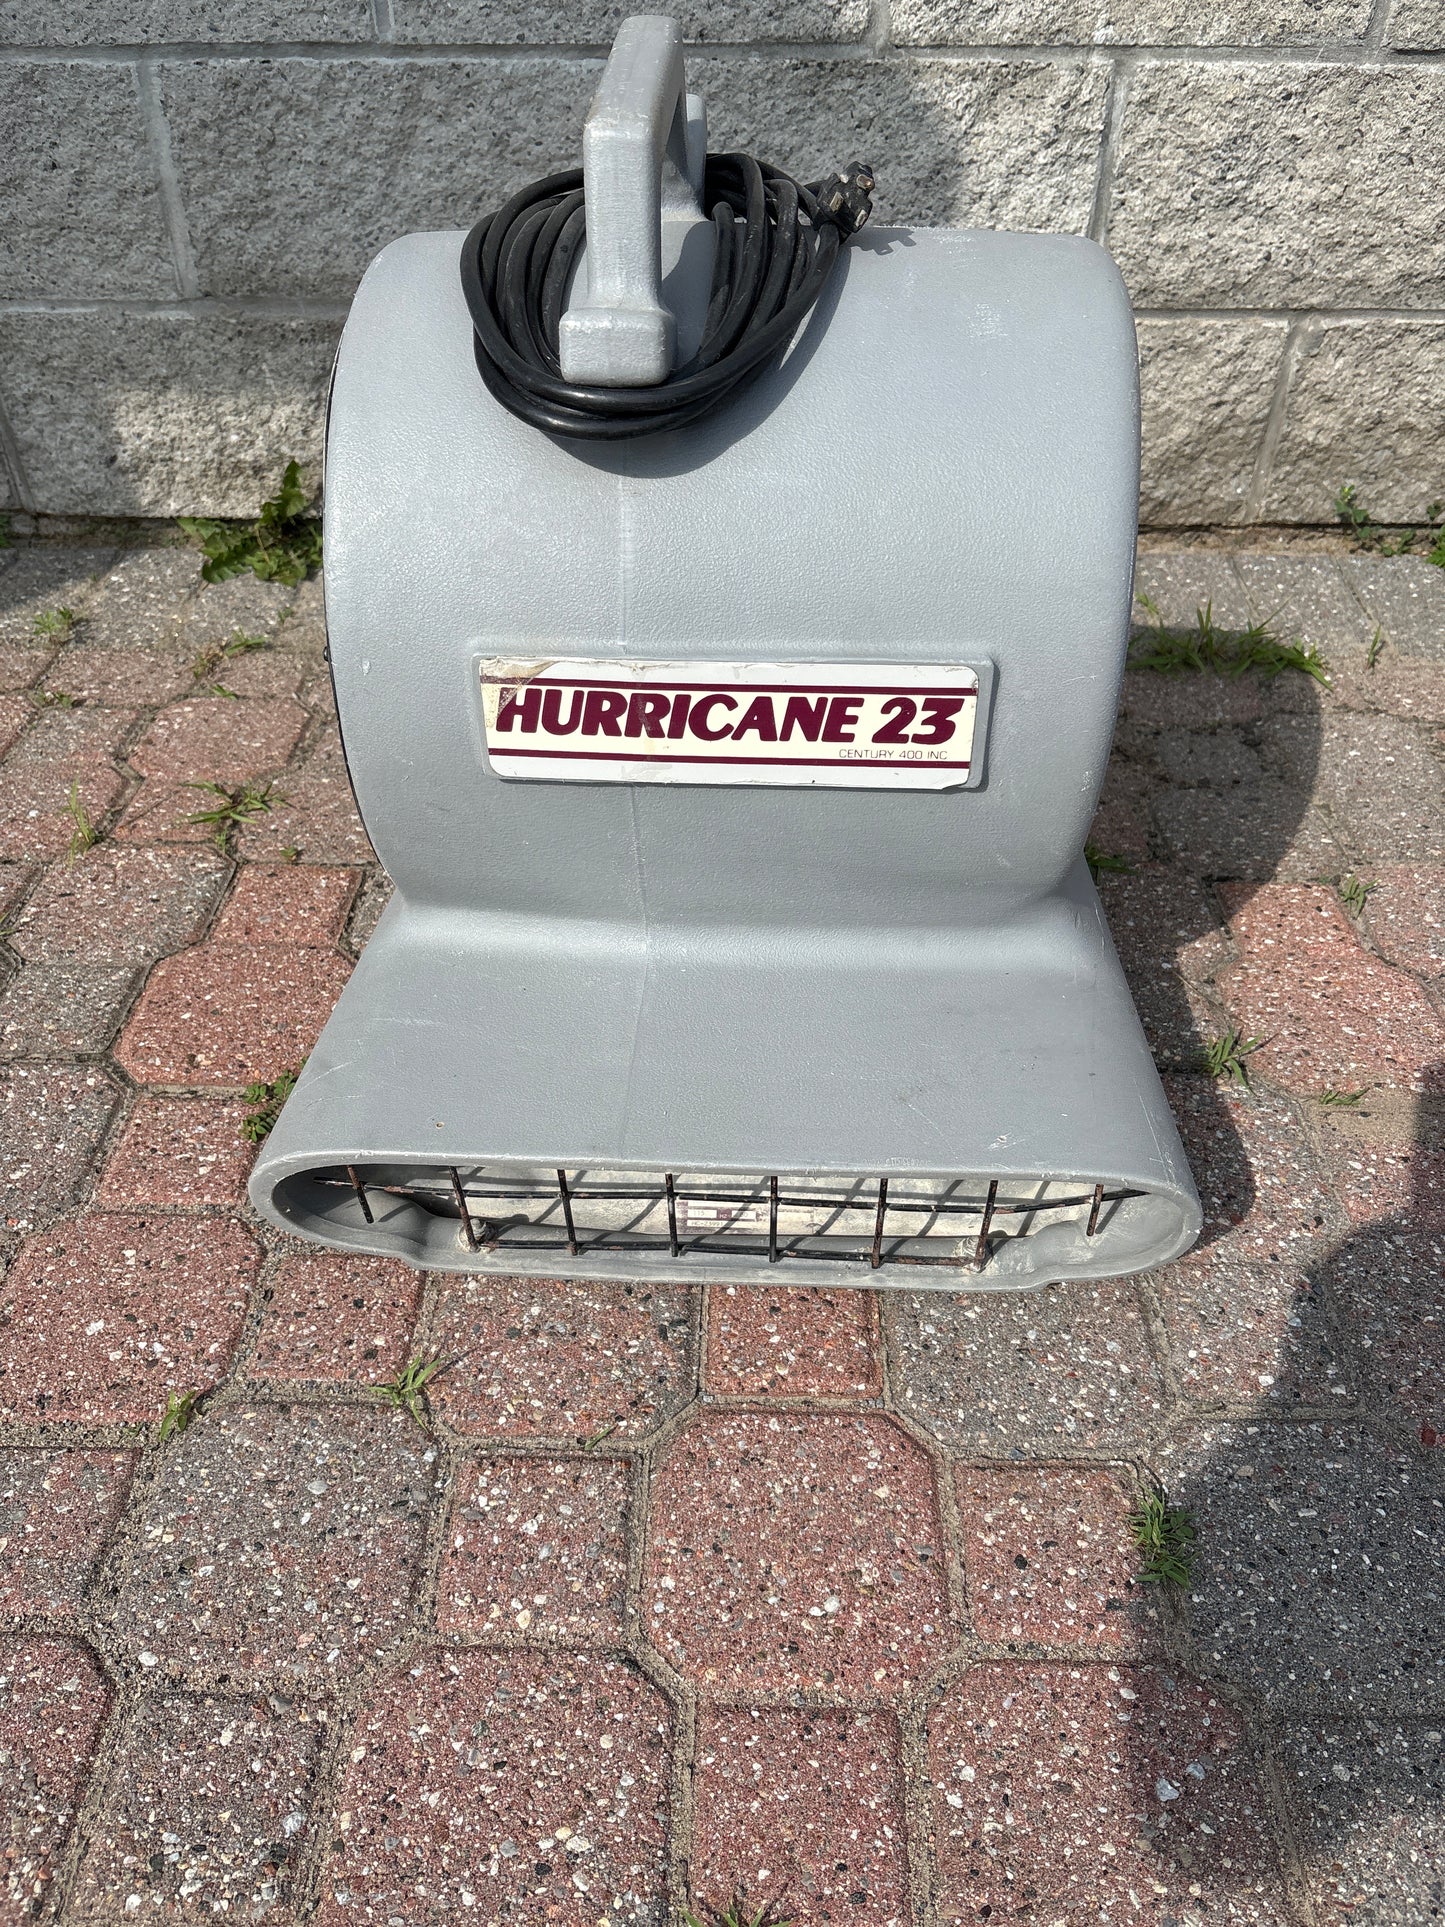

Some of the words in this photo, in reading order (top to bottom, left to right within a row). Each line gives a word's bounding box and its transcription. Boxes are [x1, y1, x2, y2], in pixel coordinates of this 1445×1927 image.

[495, 688, 865, 742] HURRICANE
[871, 696, 965, 745] 23
[838, 748, 895, 759] CENTURY
[899, 750, 923, 760] 400
[927, 750, 948, 760] INC
